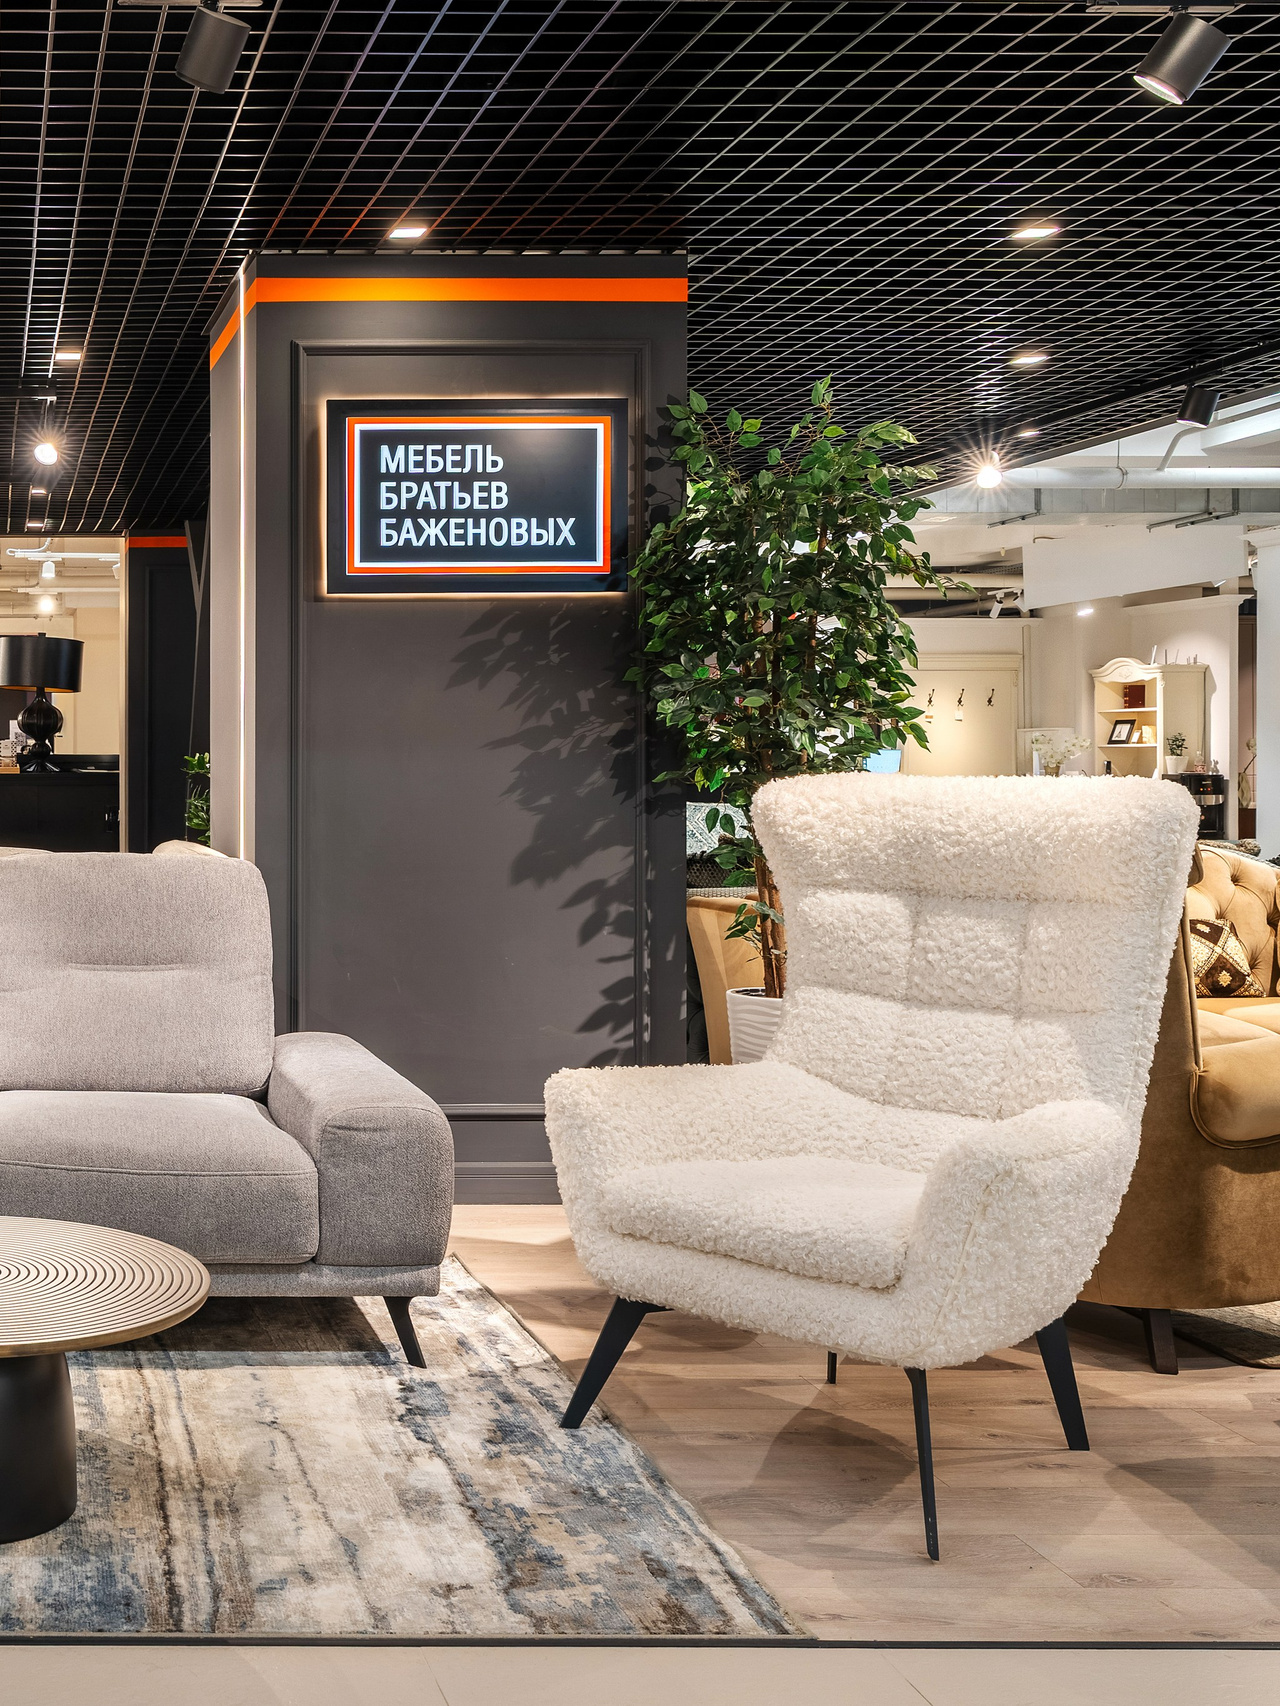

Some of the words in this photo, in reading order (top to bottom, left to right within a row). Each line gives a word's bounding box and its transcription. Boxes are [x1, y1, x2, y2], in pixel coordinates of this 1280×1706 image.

[380, 444, 504, 474] МЕБЕЛЬ
[380, 481, 509, 510] БРАТЬЕВ
[380, 518, 576, 547] БАЖЕНОВЫХ
